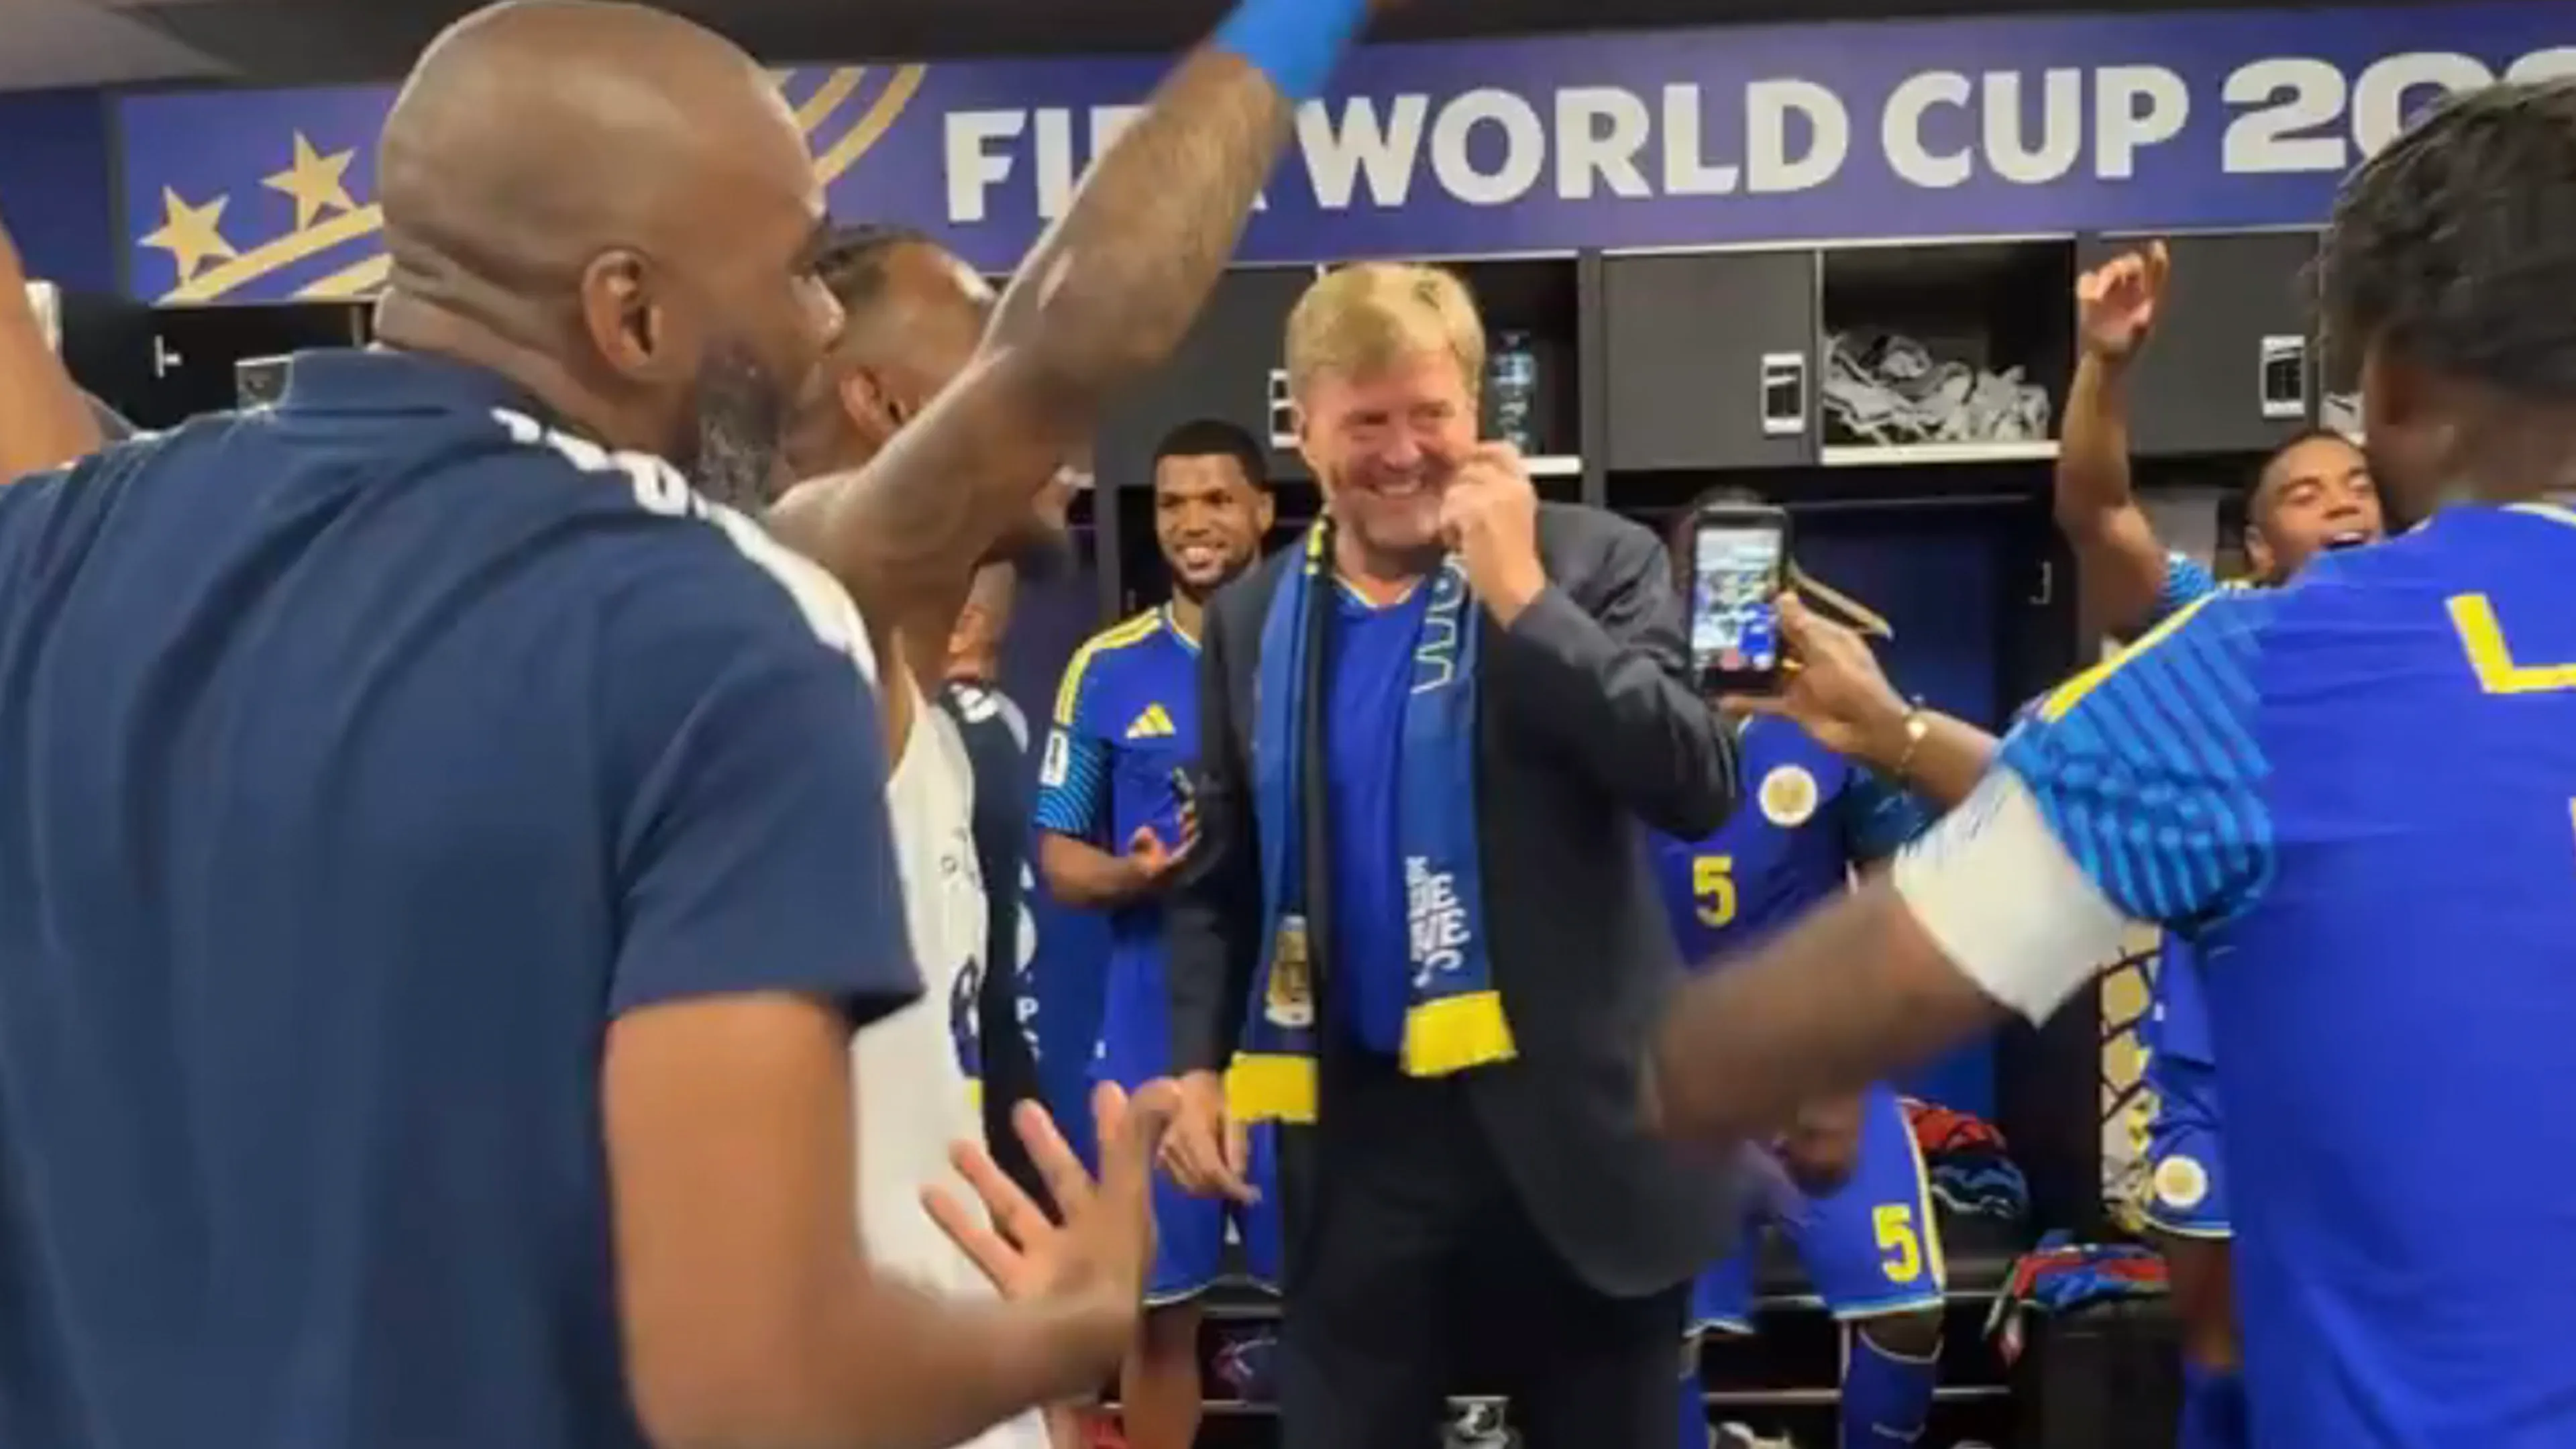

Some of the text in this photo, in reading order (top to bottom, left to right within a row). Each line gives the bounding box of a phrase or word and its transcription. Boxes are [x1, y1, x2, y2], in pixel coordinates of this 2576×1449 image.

[945, 46, 2576, 221] FI WORLD CUP 20
[1692, 855, 1736, 927] 5
[1871, 1205, 1921, 1283] 5
